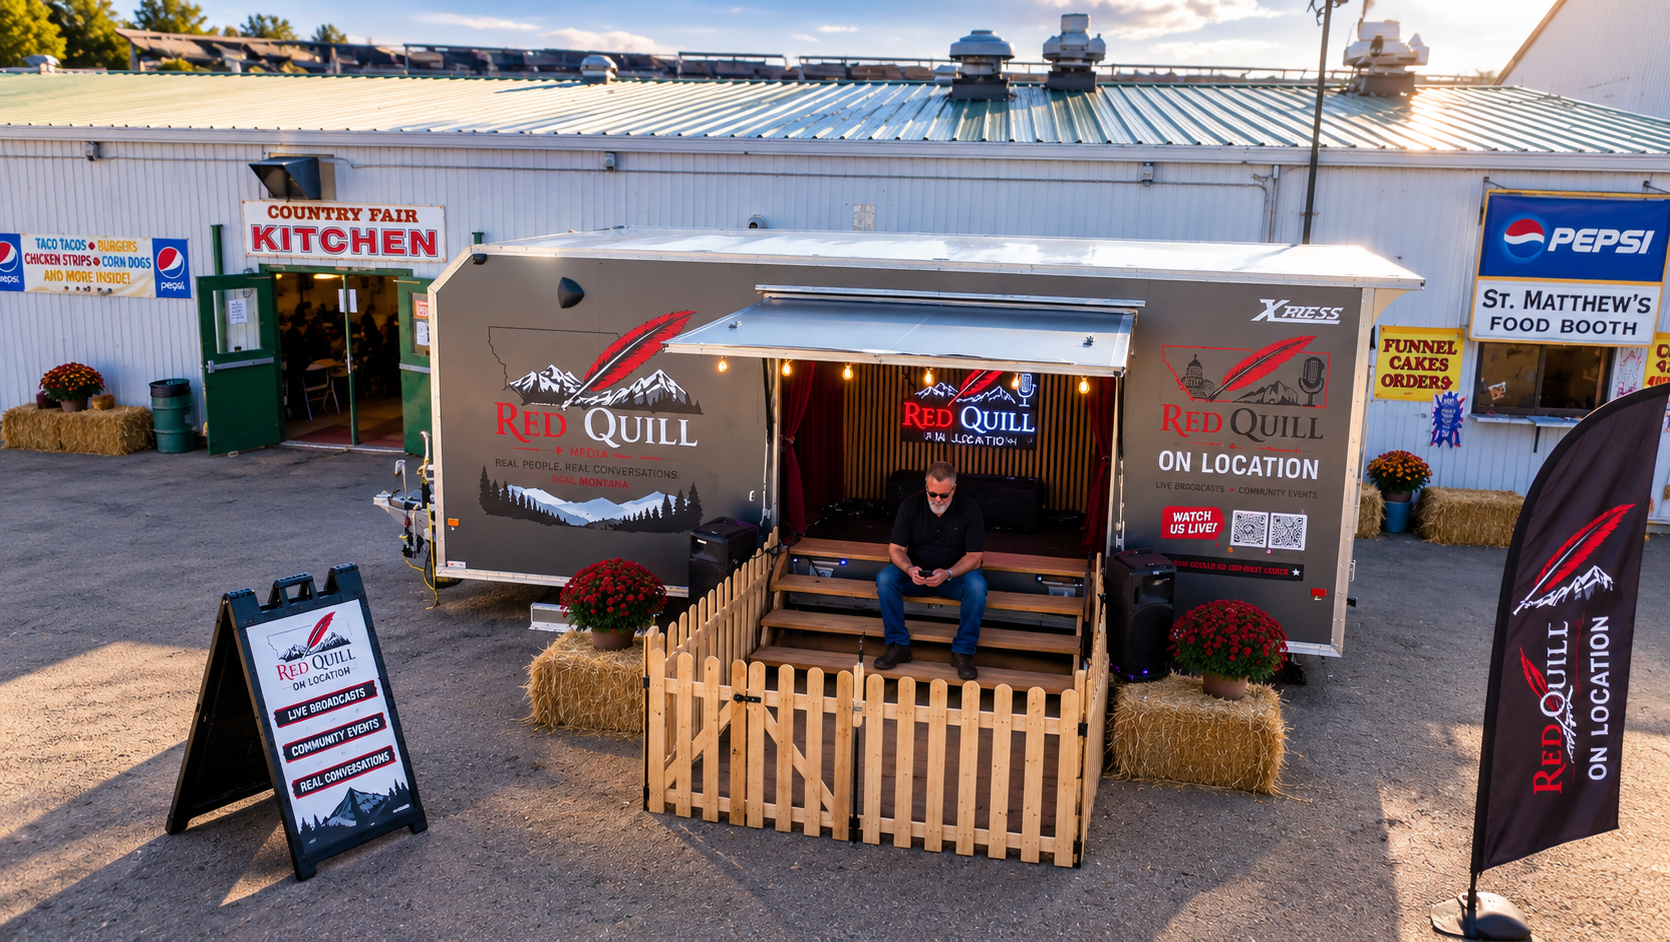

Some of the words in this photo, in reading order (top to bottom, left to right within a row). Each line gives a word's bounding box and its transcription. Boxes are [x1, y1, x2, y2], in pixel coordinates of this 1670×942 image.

[267, 204, 363, 223] COUNTRY
[369, 208, 420, 224] FAIR
[35, 237, 58, 250] TACO
[59, 238, 87, 251] TACOS
[97, 239, 138, 253] BURGERS
[251, 223, 439, 257] KITCHEN
[1547, 227, 1655, 255] PEPSI
[24, 252, 61, 266] CHICKEN
[62, 253, 92, 267] STRIPS
[102, 255, 126, 268] CORN
[128, 256, 152, 270] DOGS
[44, 269, 64, 282] AND
[65, 270, 94, 284] MORE
[96, 271, 131, 285] INSIDE!
[1522, 289, 1652, 315] MATTHEW'S
[1489, 316, 1551, 333] FOOD
[1559, 318, 1638, 336] BOOTH
[1382, 338, 1458, 355] FUNNEL
[1389, 355, 1449, 372] CAKES
[493, 401, 567, 443] RED
[583, 406, 698, 449] QUILL
[902, 401, 953, 430] RED
[960, 405, 1036, 434] QUILL
[1160, 403, 1224, 438] RED
[1229, 407, 1324, 443] QUILL
[495, 458, 520, 468] REAL
[565, 463, 590, 473] REAL
[1158, 450, 1191, 473] ON
[1201, 452, 1320, 480] LOCATION
[1155, 481, 1173, 490] LIVE
[1238, 486, 1286, 498] COMMUNITY
[1288, 489, 1318, 499] EVENTS
[1169, 523, 1185, 534] US
[1187, 522, 1219, 534] LIVE!
[1172, 510, 1212, 523] WATCH
[276, 661, 309, 681] RED
[311, 648, 356, 671] QUILL
[1540, 620, 1570, 718] QUILL
[1589, 616, 1611, 736] LOCATION
[287, 705, 308, 721] LIVE
[310, 687, 366, 714] BROADCASTS
[291, 729, 346, 757] COMMUNITY
[346, 718, 380, 738] EVENTS
[1533, 724, 1567, 795] RED
[1587, 746, 1608, 781] ON
[300, 775, 324, 793] REAL
